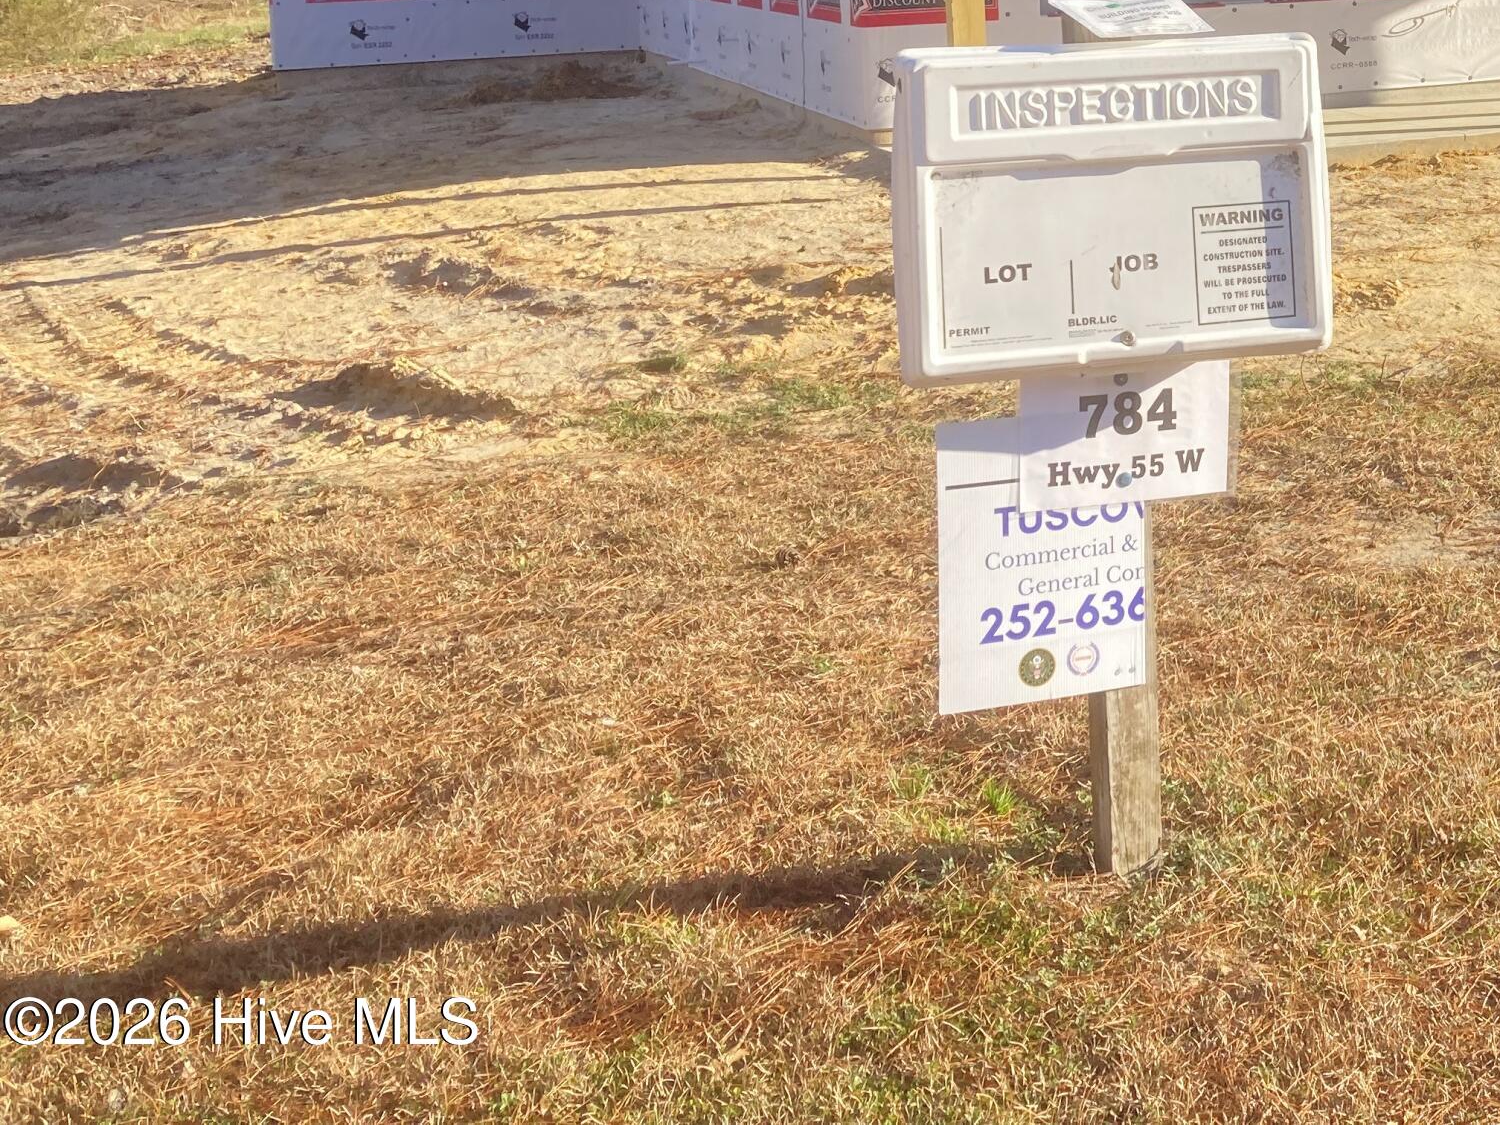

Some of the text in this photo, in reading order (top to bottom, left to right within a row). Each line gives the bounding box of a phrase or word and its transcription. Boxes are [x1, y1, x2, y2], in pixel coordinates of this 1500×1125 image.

[971, 78, 1258, 131] INSPECTIONS
[1200, 208, 1283, 226] WARNING
[1219, 236, 1267, 247] DESIGNATED
[1109, 253, 1159, 273] JOB
[1203, 248, 1285, 261] CONSTRUCTION SITE.
[984, 263, 1032, 284] LOT
[1218, 262, 1271, 273] TRESPASSERS
[1203, 274, 1287, 288] WILL BE PROSECUTED
[1222, 288, 1270, 300] TO THE FULL
[1207, 300, 1286, 315] EXTENT OF THE LAW.
[1068, 315, 1118, 327] BLDR.LIC
[949, 326, 990, 338] PERMIT
[1079, 387, 1177, 439] 784
[1131, 453, 1164, 479] 55
[1175, 448, 1205, 474] W
[985, 533, 1138, 571] Commercial &
[1018, 567, 1100, 596] General
[979, 586, 1144, 644] 252-636
